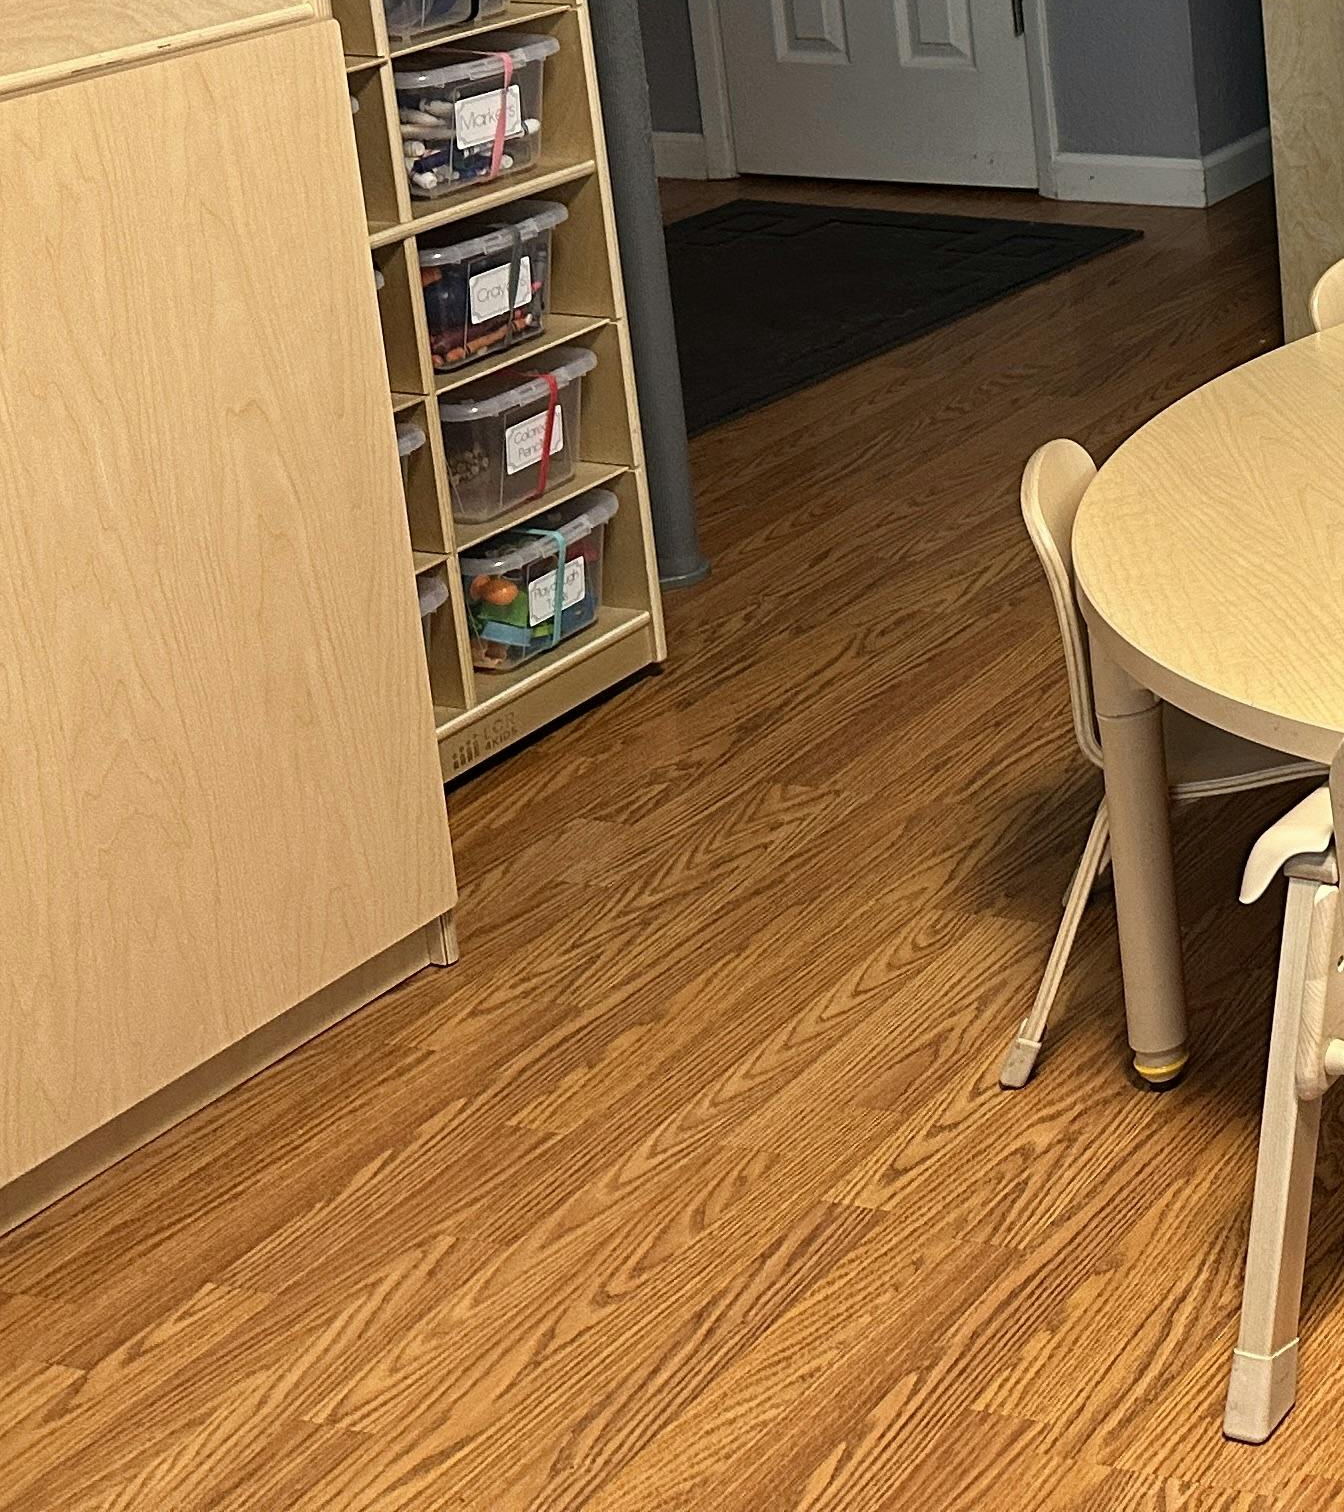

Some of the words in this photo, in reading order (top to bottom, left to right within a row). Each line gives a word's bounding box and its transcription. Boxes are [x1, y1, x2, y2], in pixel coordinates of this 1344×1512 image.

[460, 105, 516, 130] Markes
[477, 279, 527, 303] Crays
[514, 424, 547, 445] Colore
